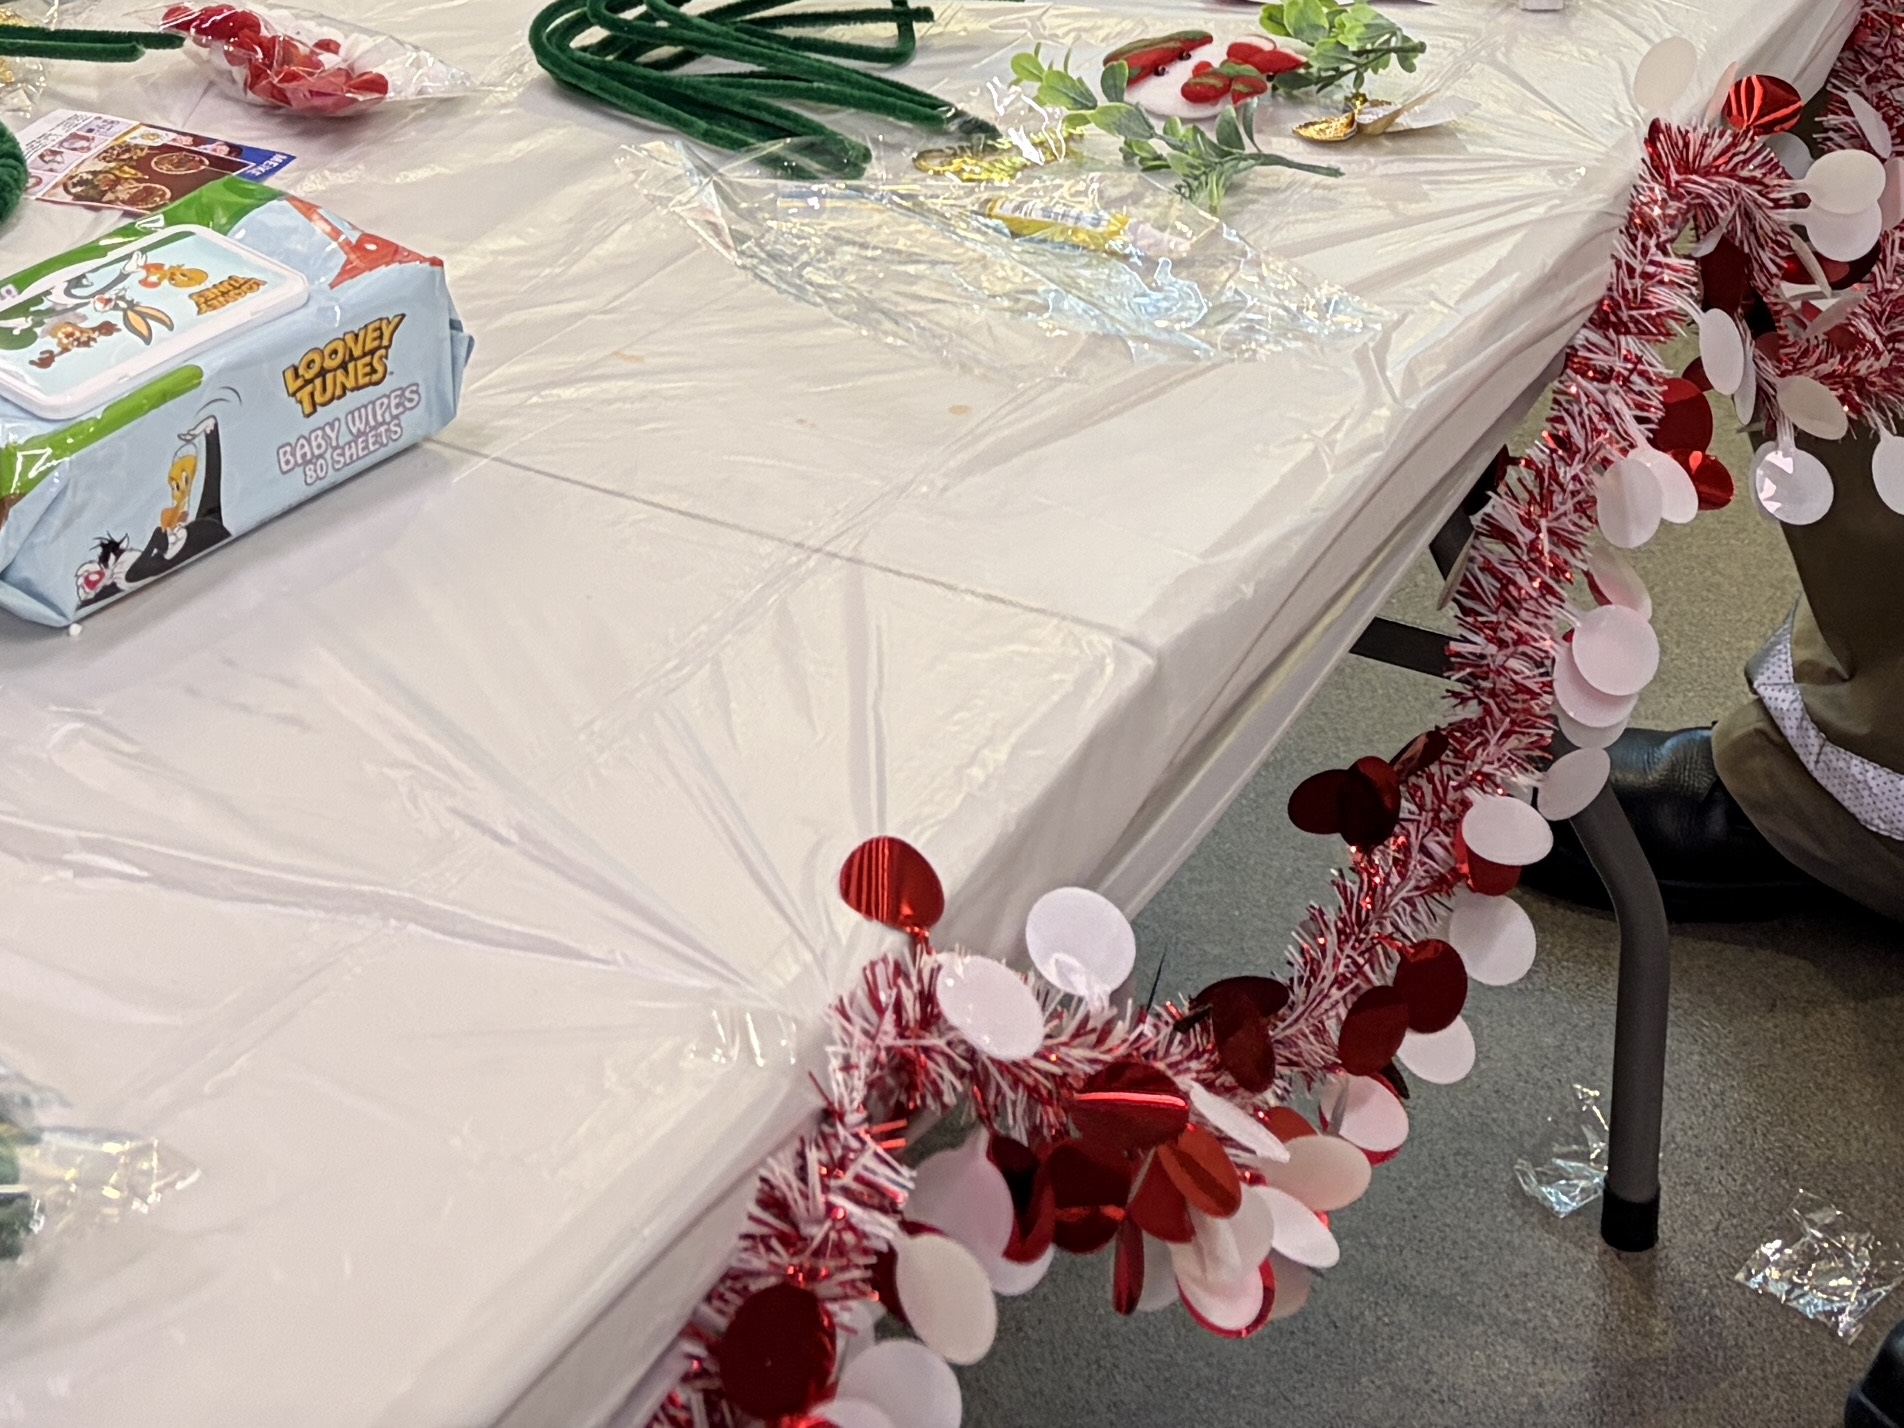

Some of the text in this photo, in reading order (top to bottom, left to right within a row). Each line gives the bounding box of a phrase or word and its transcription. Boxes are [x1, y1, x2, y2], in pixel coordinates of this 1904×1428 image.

[282, 313, 406, 397] LOONEY
[296, 348, 389, 418] TUNES
[277, 383, 421, 475] BABY WIPES
[304, 418, 403, 486] 80 SHEETS
